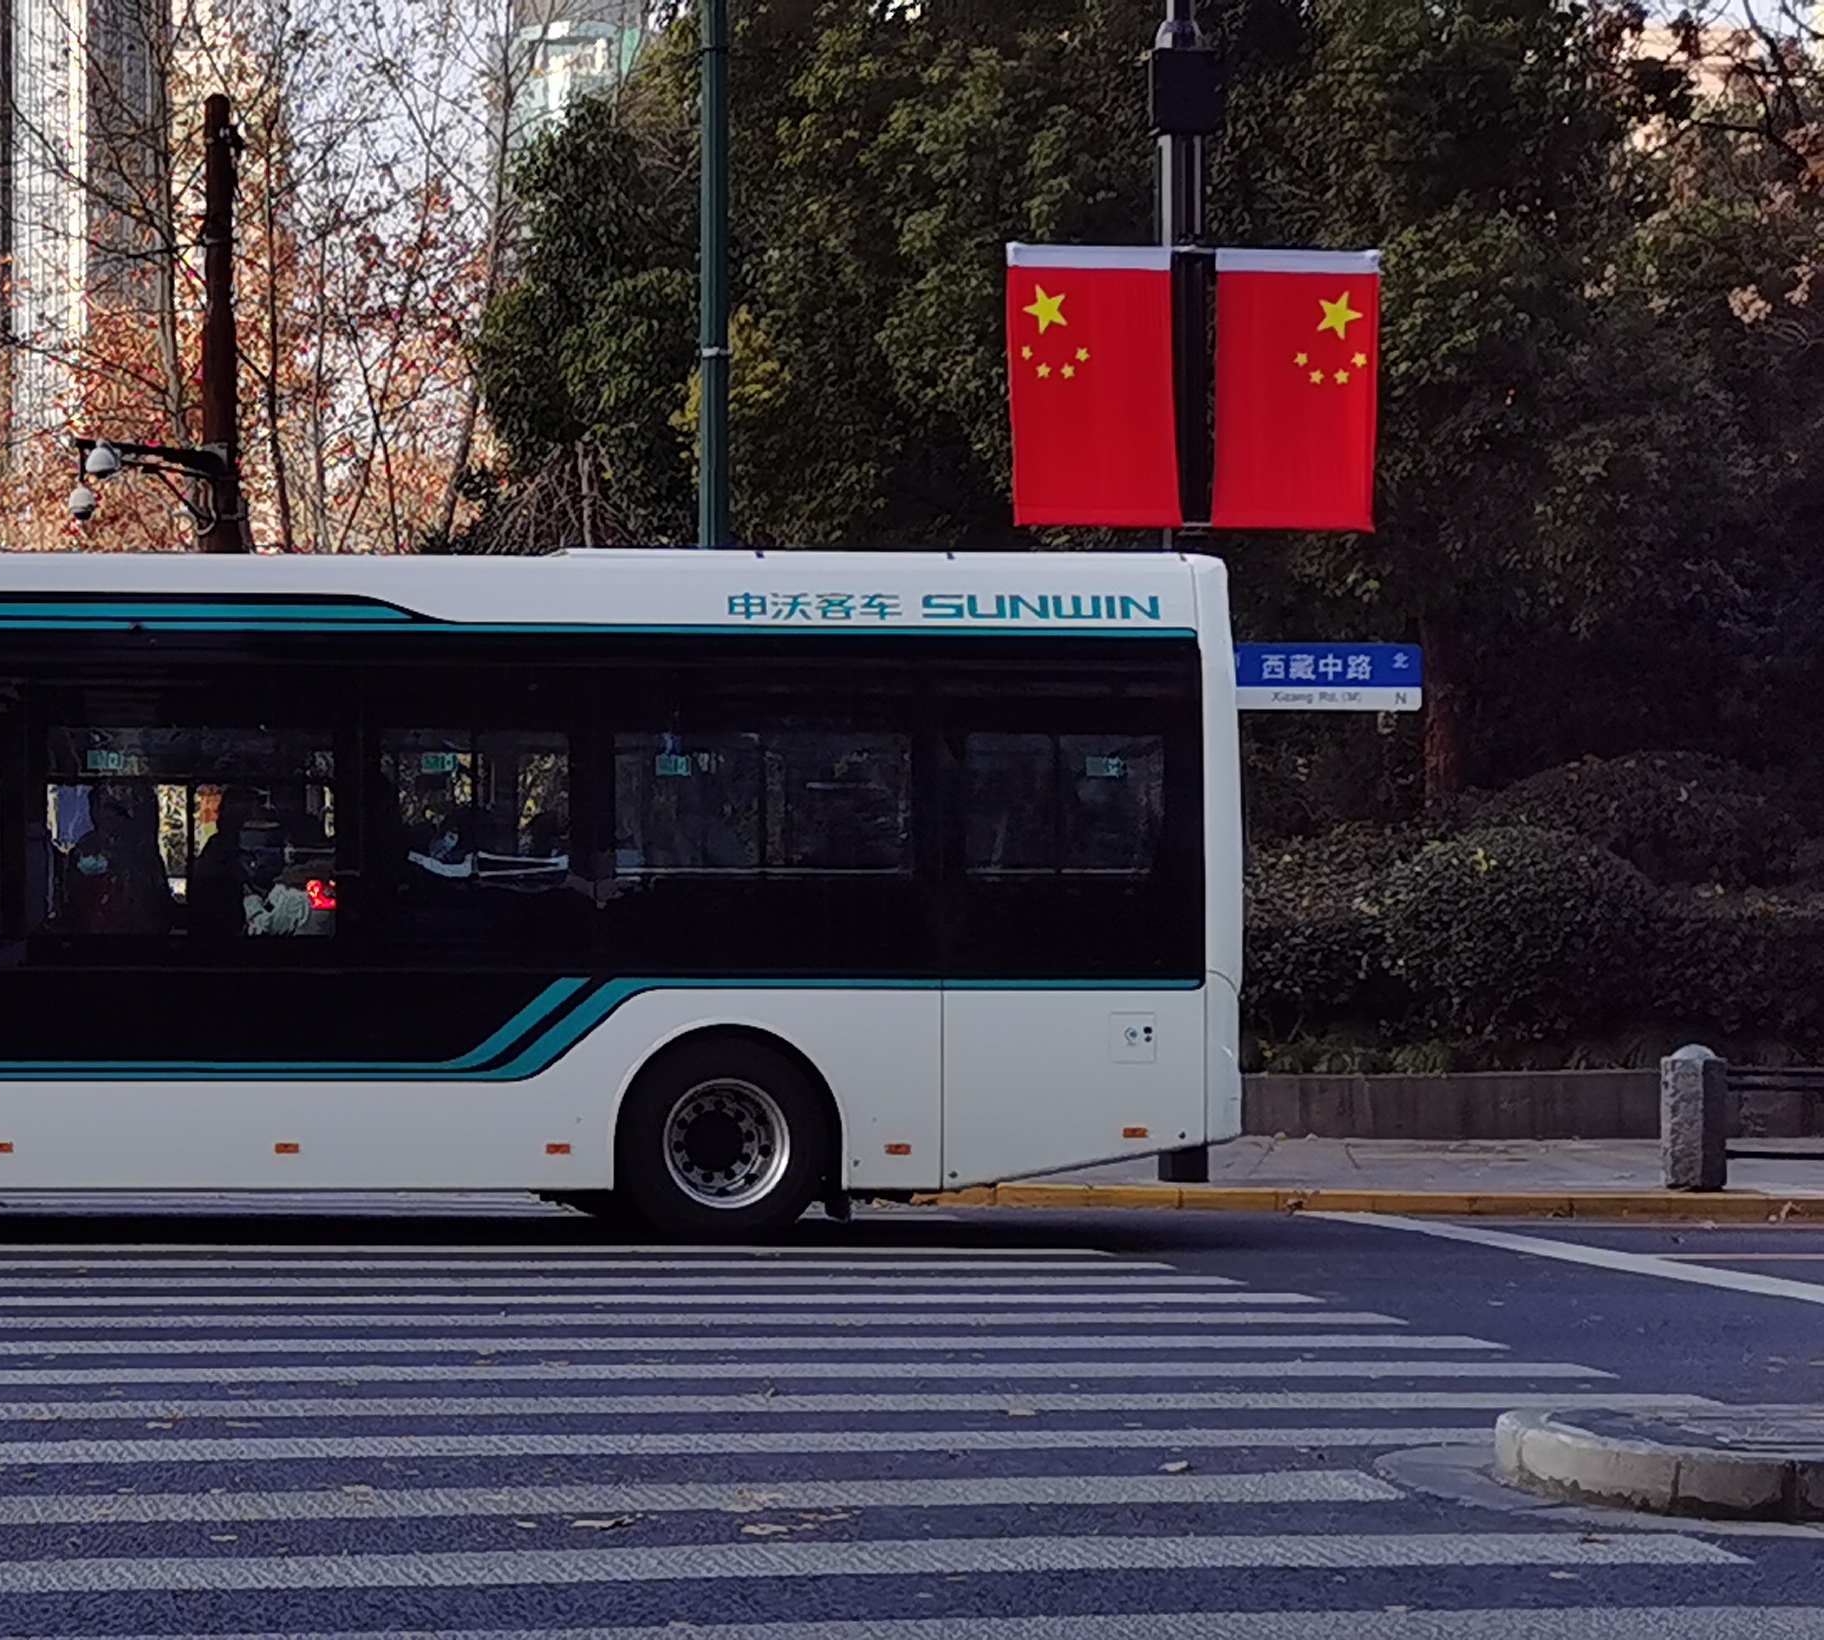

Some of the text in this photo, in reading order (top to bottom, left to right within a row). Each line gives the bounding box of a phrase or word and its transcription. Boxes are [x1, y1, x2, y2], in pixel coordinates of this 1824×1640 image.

[727, 593, 903, 621] 申沃客车
[921, 594, 1161, 620] SUNWIN
[1261, 653, 1373, 681] 西藏中路
[1393, 652, 1410, 669] 北
[1271, 690, 1314, 704] Xizang
[1395, 691, 1408, 705] N
